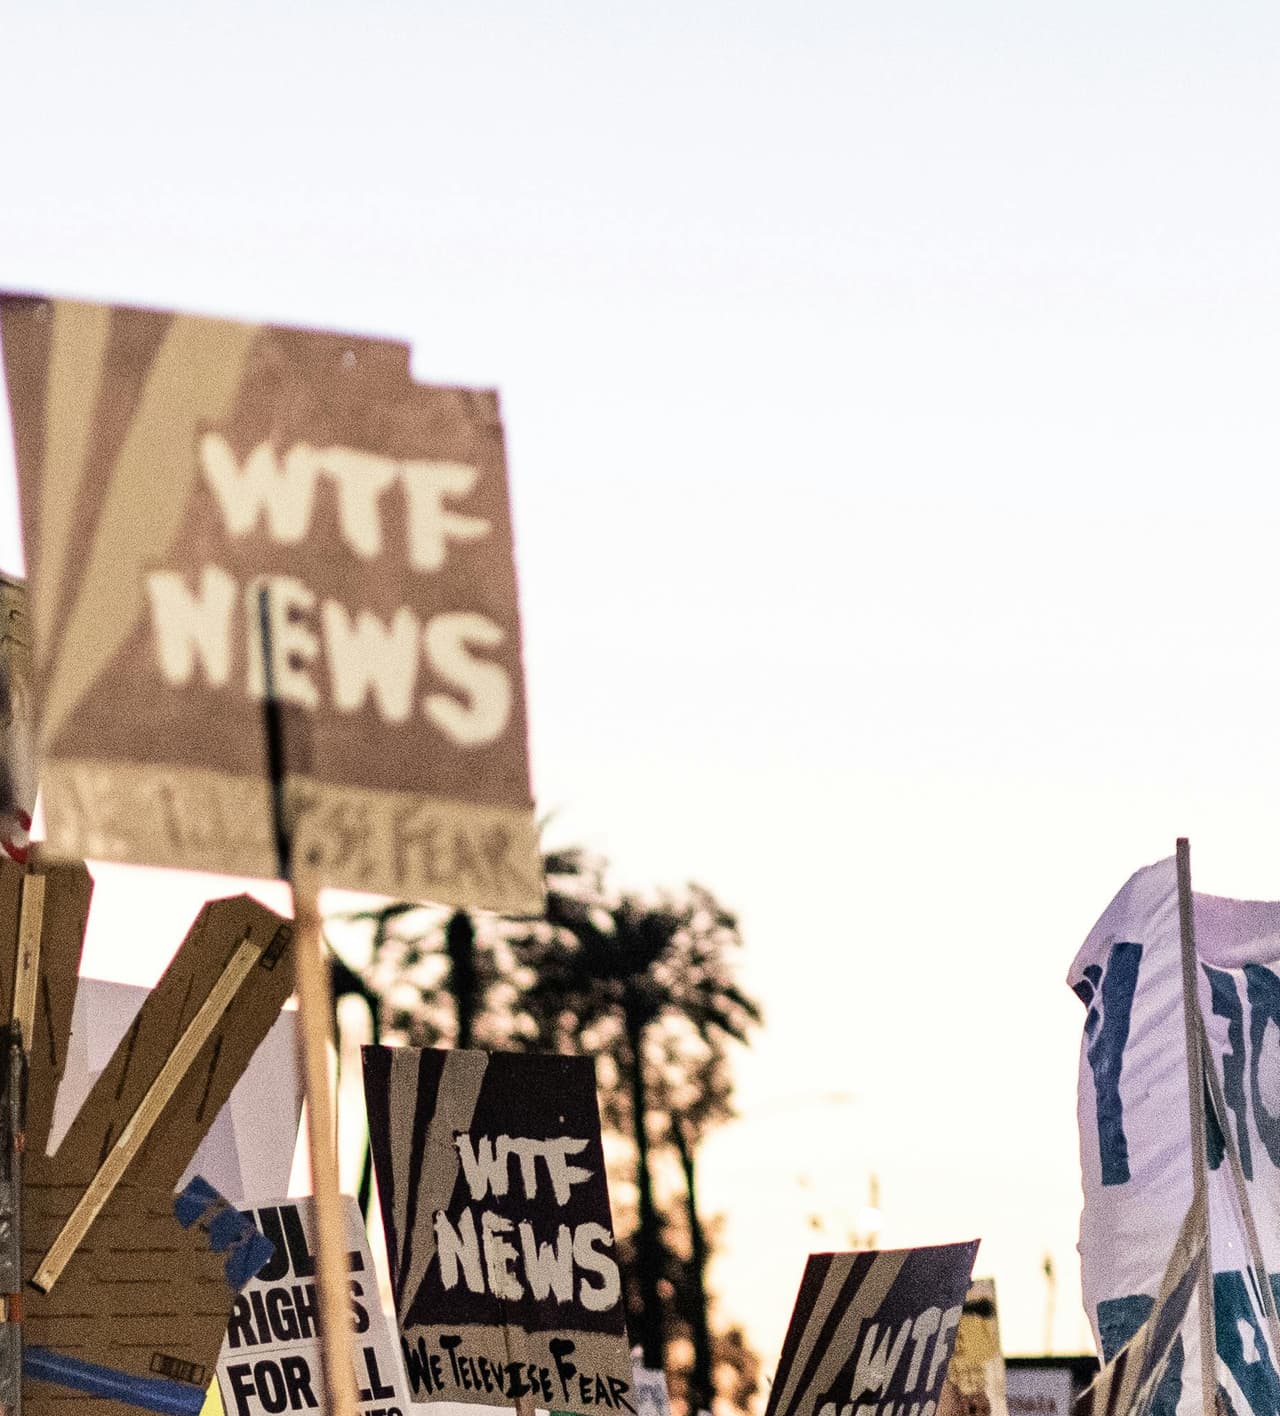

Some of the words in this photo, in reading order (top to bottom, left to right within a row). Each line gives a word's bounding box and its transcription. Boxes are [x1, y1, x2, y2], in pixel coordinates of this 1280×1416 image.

[197, 432, 492, 572] WTF
[145, 565, 513, 747] NEWS
[454, 1131, 595, 1204] WTF
[435, 1206, 621, 1312] NEWS
[228, 1280, 370, 1348] RIGHS
[851, 1306, 964, 1400] WTF
[550, 1338, 639, 1414] FEAR
